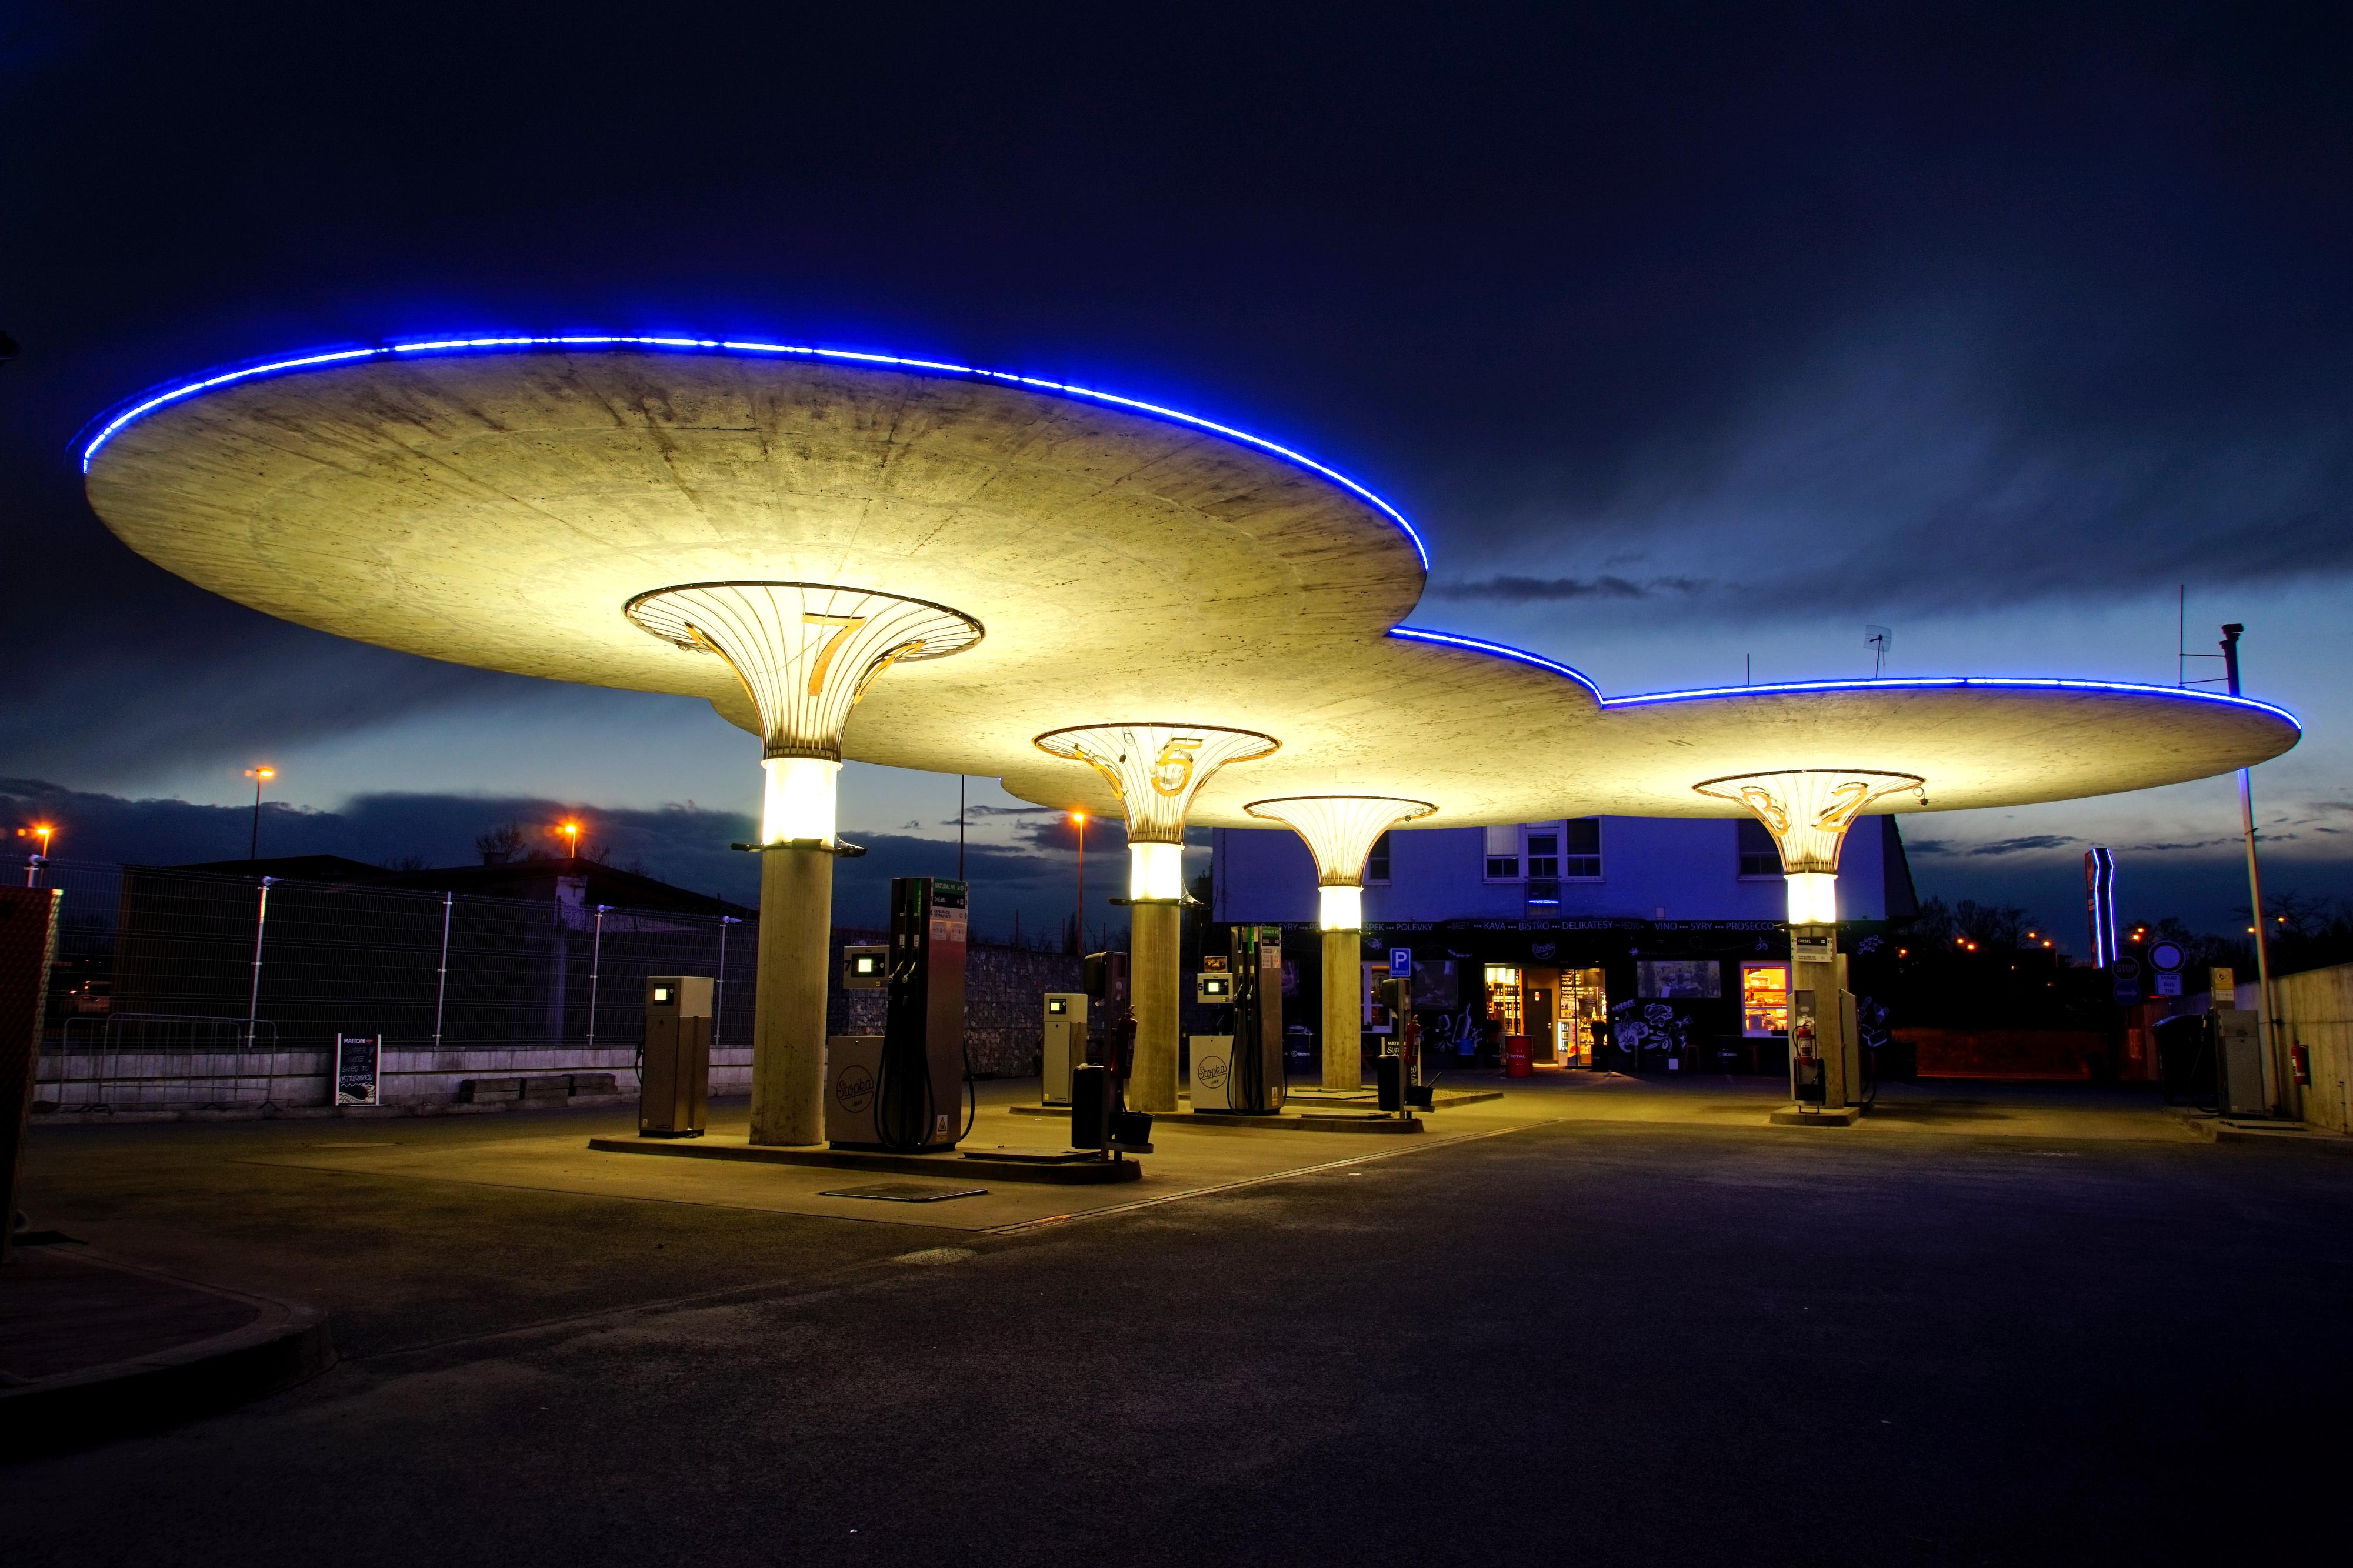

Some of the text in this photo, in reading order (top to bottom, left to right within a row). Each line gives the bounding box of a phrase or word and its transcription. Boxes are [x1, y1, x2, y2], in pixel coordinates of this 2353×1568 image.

[802, 613, 866, 696] 7
[1151, 738, 1204, 797] 5
[1742, 788, 1789, 836] 3
[1815, 784, 1868, 833] 2
[1519, 922, 1550, 930] BISTRO
[1562, 920, 1614, 930] DELIKATESY
[1655, 920, 1775, 930] VÍNO SÝRY PROSECCO
[844, 960, 851, 972] 7
[1395, 951, 1407, 968] P
[2116, 964, 2136, 973] STOP
[1198, 983, 1203, 991] 5
[1198, 1065, 1227, 1079] Stopka
[836, 1077, 874, 1099] Stopka
